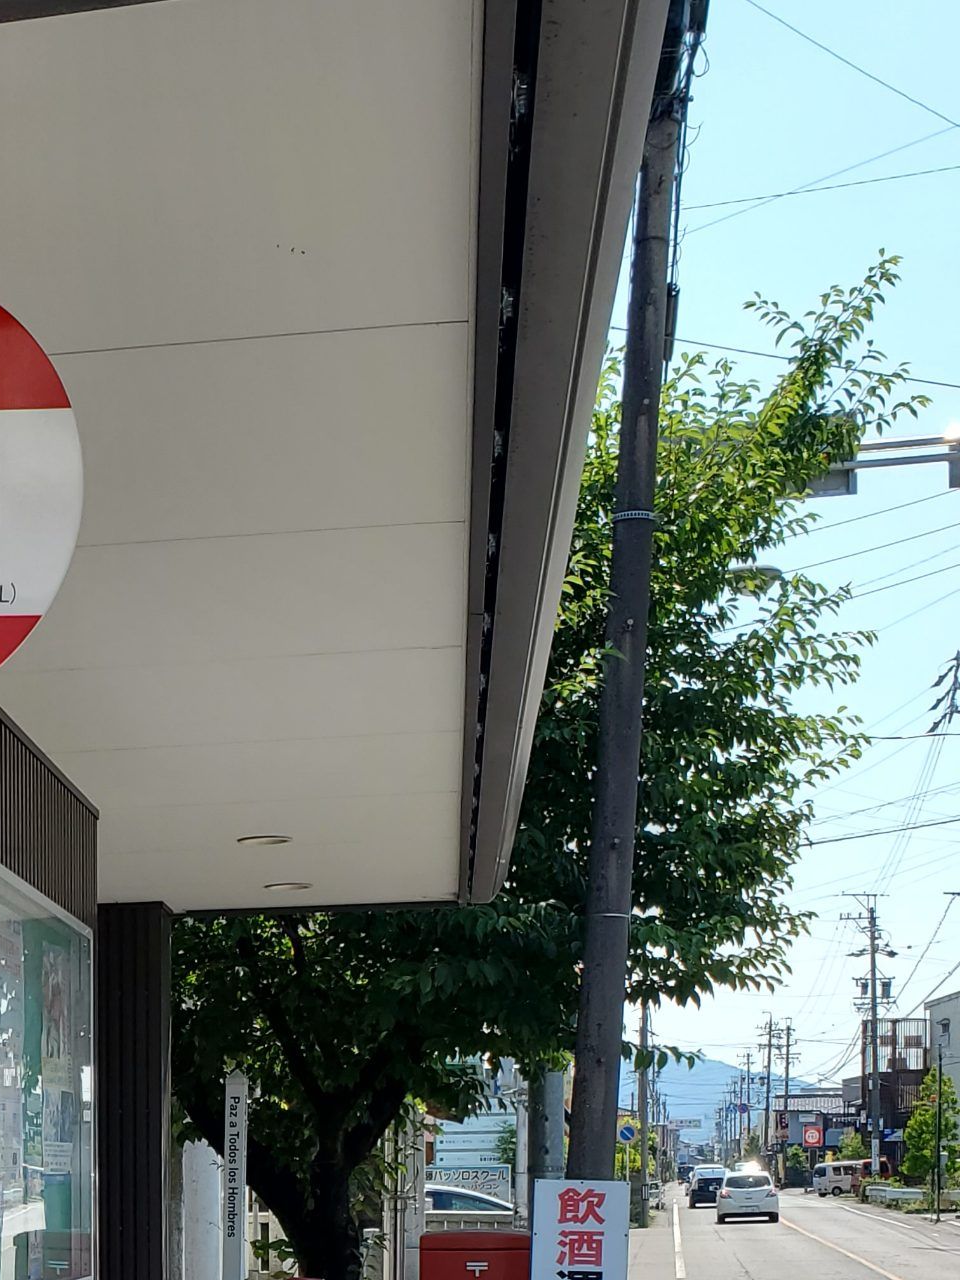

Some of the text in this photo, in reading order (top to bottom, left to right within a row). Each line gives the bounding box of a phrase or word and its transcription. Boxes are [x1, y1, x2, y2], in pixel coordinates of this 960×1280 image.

[229, 1096, 240, 1118] Paz
[228, 1132, 239, 1165] Todos
[228, 1167, 239, 1184] los
[227, 1186, 238, 1238] Hombres
